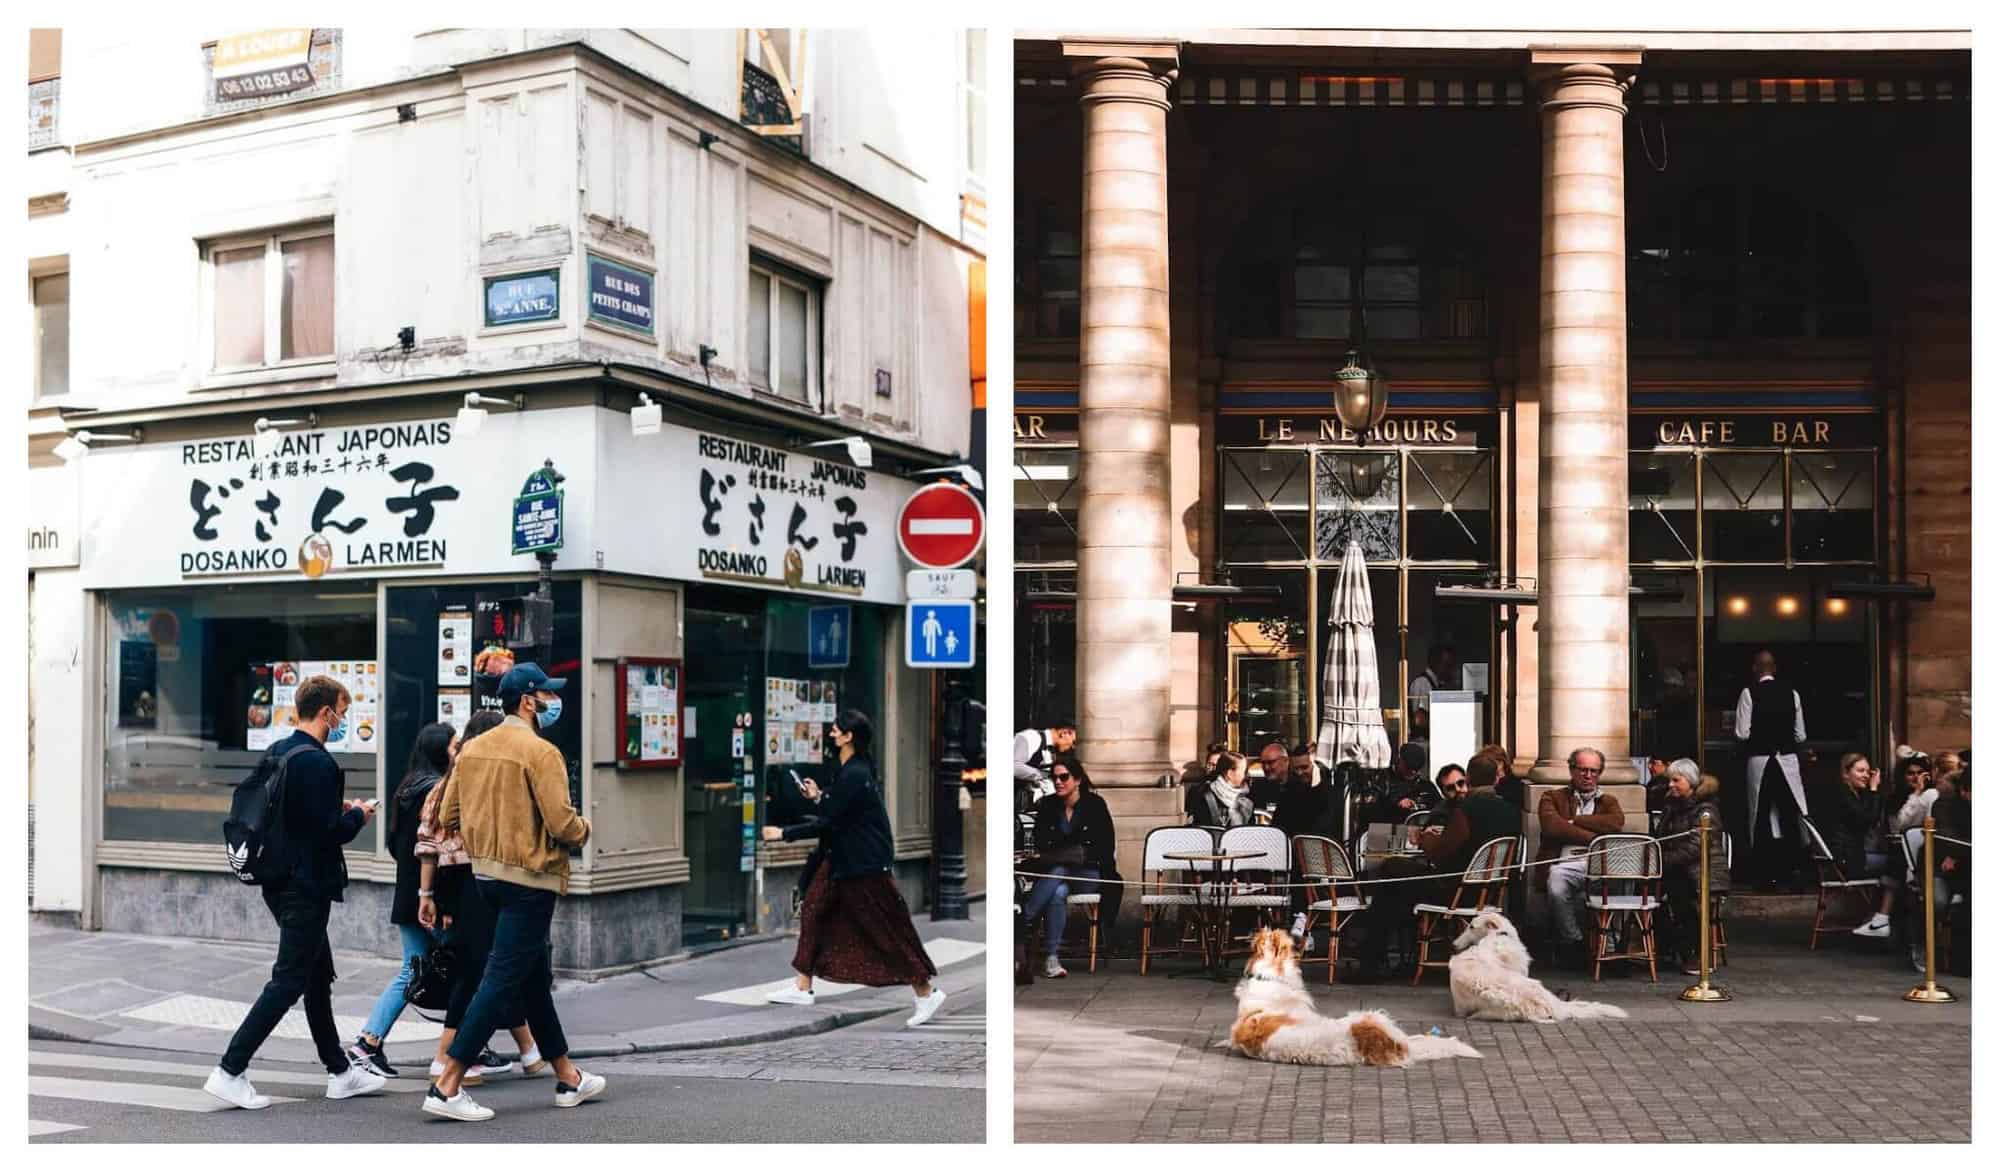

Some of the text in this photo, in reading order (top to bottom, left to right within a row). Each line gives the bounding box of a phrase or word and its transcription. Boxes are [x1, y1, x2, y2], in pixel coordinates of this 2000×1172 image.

[254, 75, 274, 90] 02
[604, 274, 641, 297] RUE DES
[592, 291, 651, 319] PETITS CHAMPS
[183, 421, 451, 465] RESTAANT JAPONAIS
[1259, 419, 1295, 441] LE
[1659, 421, 1831, 444] CAFE BAR
[698, 434, 867, 490] RESTAURANT JAPONAIS
[190, 461, 460, 543] どさん子
[699, 467, 868, 563] どさん子
[181, 539, 447, 573] DOSANKO LARMEN
[698, 548, 867, 588] DOSANKO LARMEN
